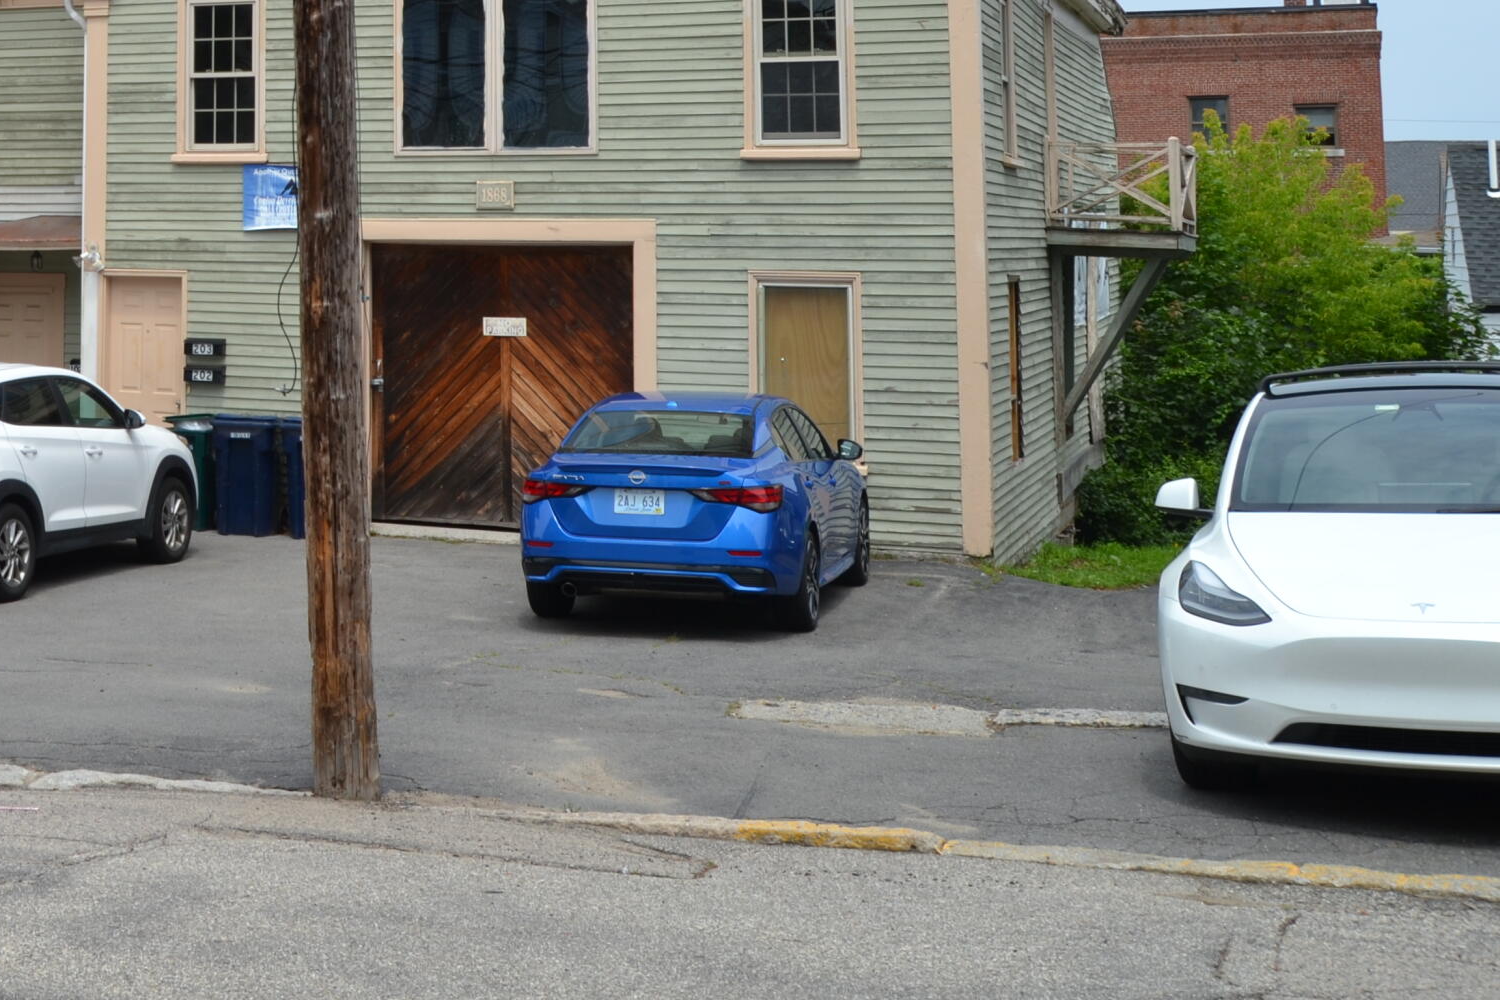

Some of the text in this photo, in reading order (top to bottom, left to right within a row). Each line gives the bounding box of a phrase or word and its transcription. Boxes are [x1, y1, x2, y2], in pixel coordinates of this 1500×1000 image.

[486, 326, 524, 336] PARKING
[193, 344, 212, 354] 203
[193, 370, 212, 380] 202
[617, 494, 660, 508] 2AJ 634
